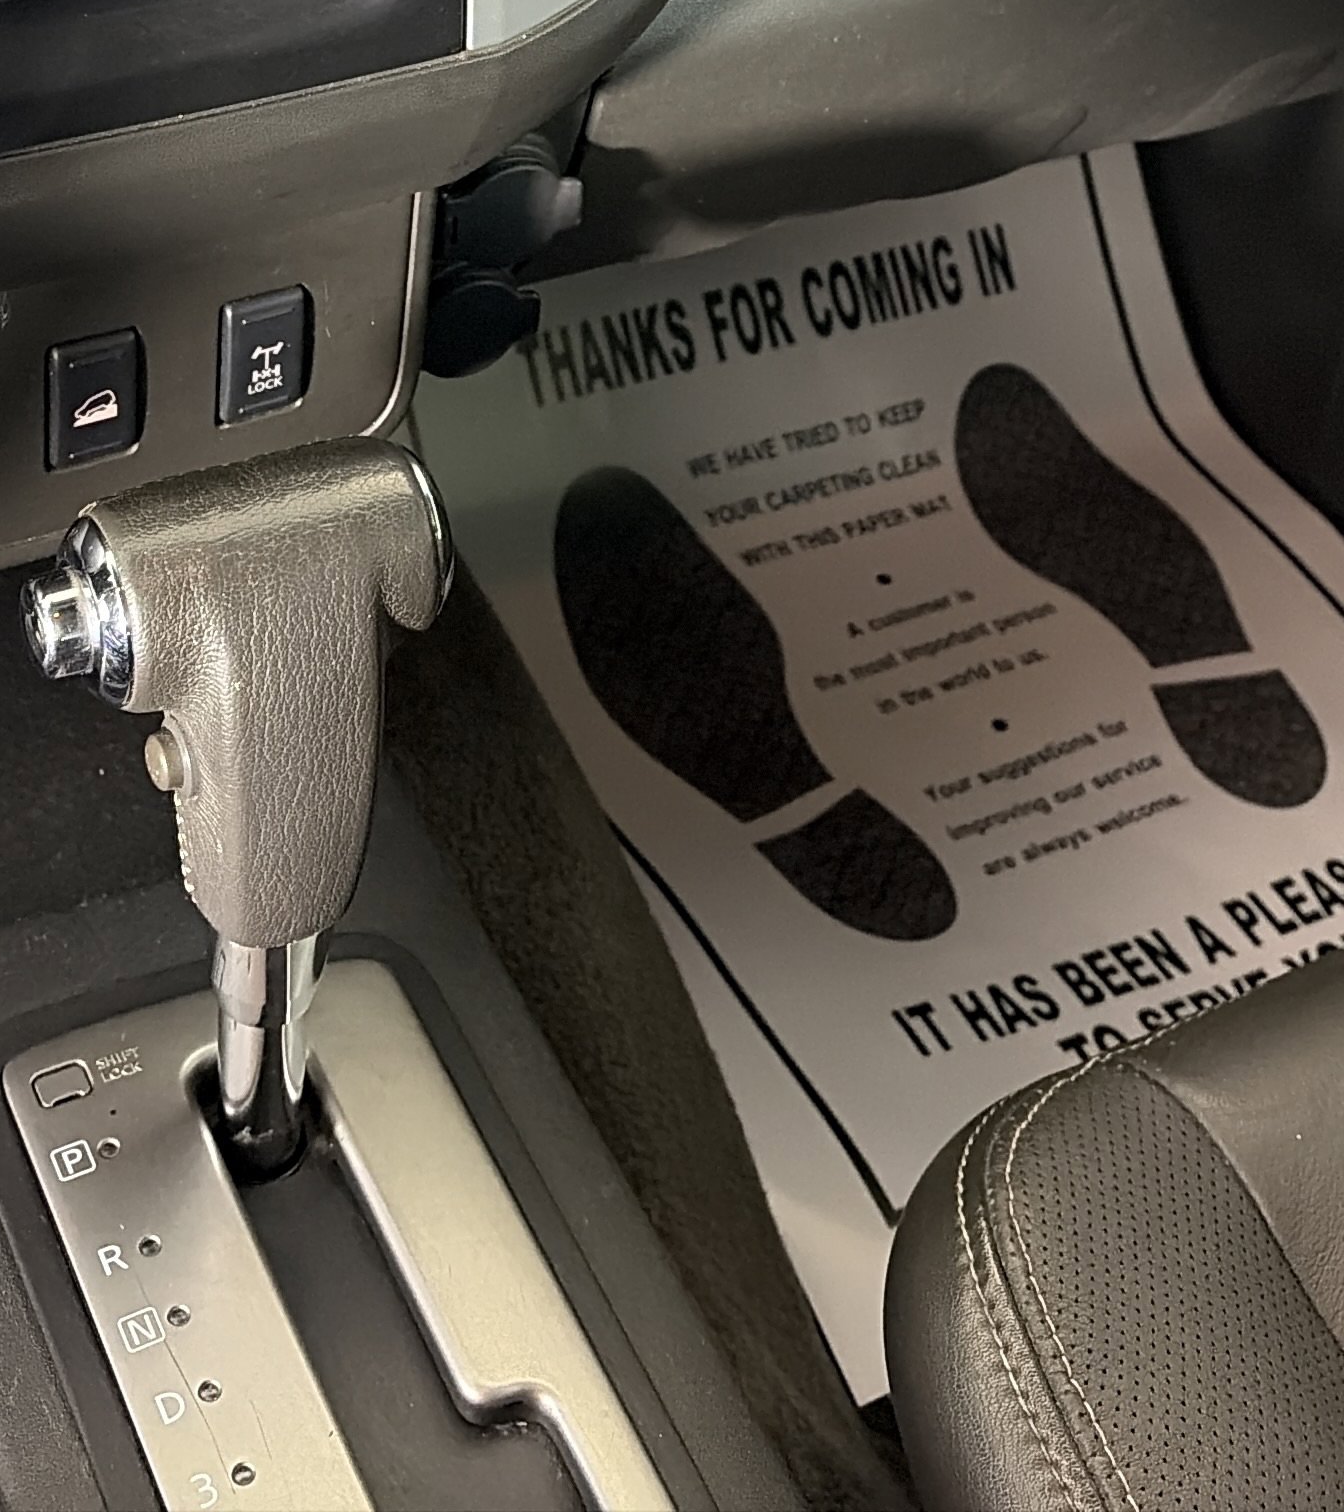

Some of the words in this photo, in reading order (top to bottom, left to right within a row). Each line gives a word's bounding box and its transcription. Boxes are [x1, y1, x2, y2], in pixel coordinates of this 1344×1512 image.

[515, 298, 696, 408] THANKS
[702, 276, 796, 363] FOR
[800, 234, 963, 339] COMING
[967, 222, 1018, 297] IN
[247, 374, 284, 396] LOCK
[686, 453, 721, 479] WE
[723, 437, 779, 467] HAVE
[782, 421, 840, 452] TRIED
[843, 412, 872, 436] TO
[877, 397, 926, 427] KEEP
[704, 495, 763, 528] YOUR
[765, 466, 875, 511] CARPETING
[877, 448, 942, 481] CLEAN
[842, 507, 910, 538] PAPER
[890, 1000, 953, 1058] IT
[951, 973, 1061, 1043] HAS
[1052, 928, 1192, 1007] BEEN
[1184, 914, 1237, 966] A
[100, 1061, 143, 1084] LOCK
[61, 1146, 85, 1175] P
[96, 1245, 129, 1277] R
[126, 1314, 158, 1346] N
[153, 1391, 186, 1426] D
[188, 1472, 219, 1510] 3
